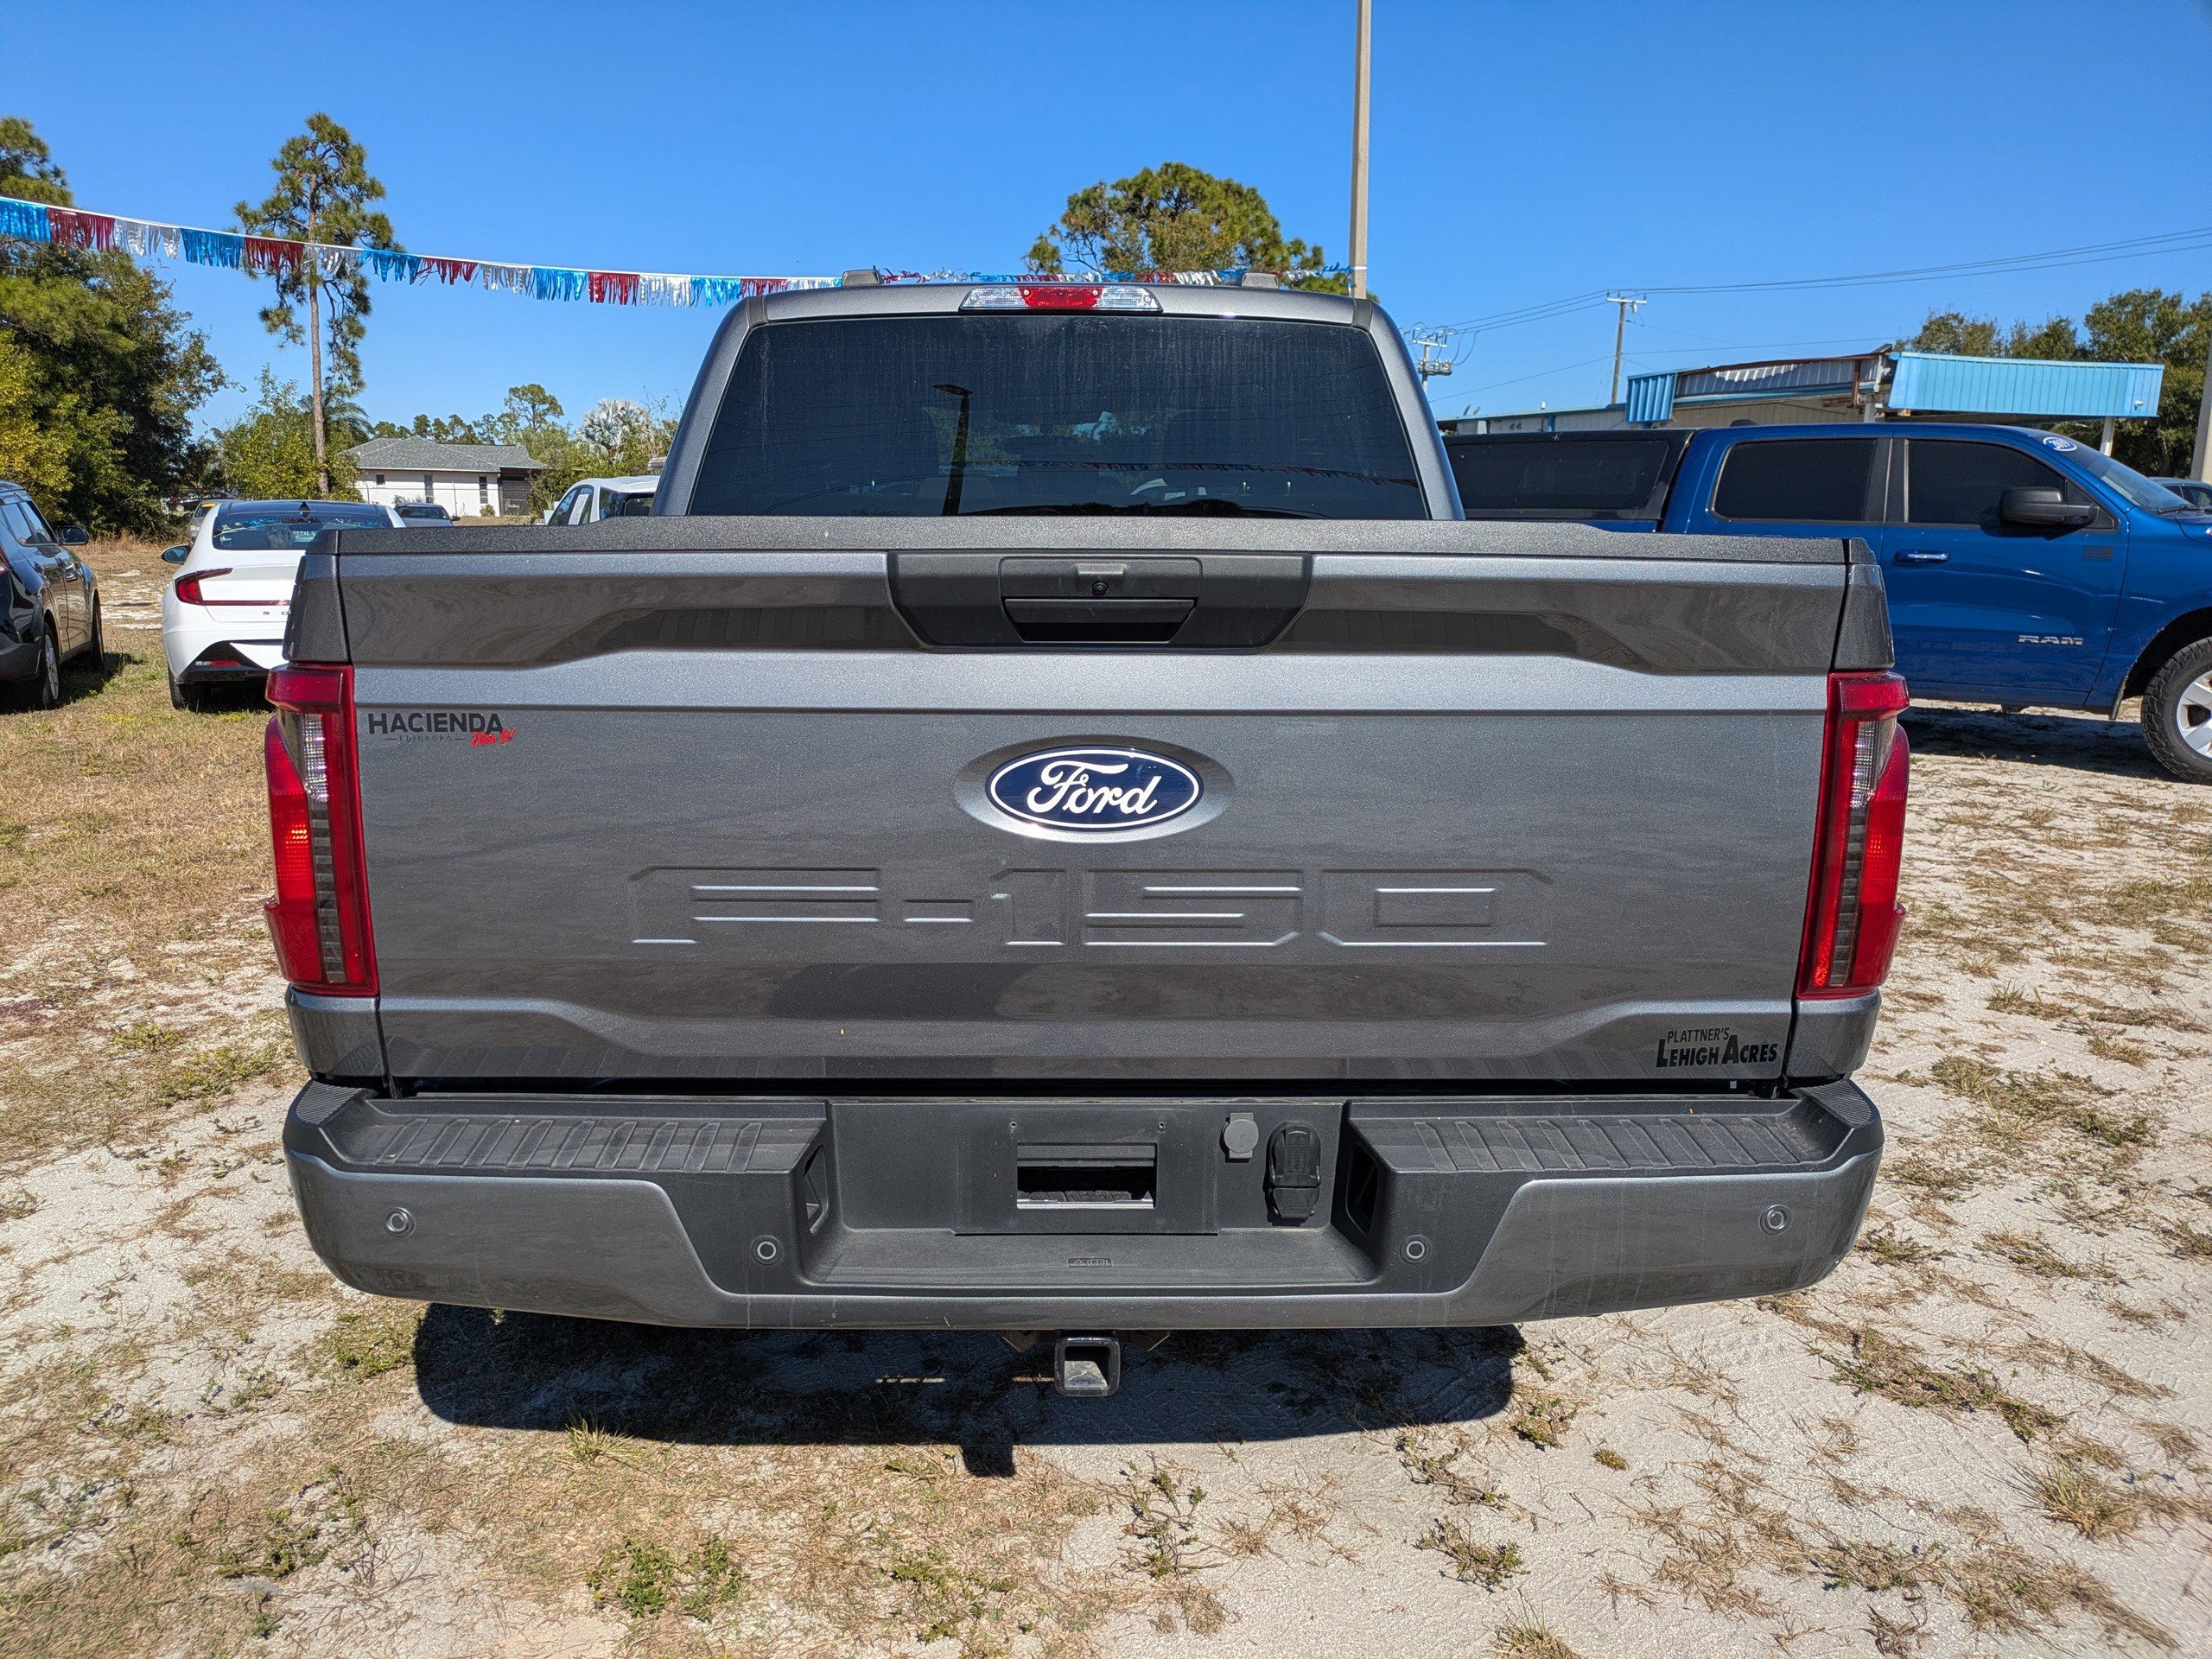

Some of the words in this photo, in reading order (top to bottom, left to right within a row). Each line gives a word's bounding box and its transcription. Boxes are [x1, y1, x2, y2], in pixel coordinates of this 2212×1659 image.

[2018, 634, 2083, 645] RAM
[367, 712, 504, 734] HACIENDA
[1027, 760, 1162, 815] Ford
[628, 866, 1555, 947] F-150
[1667, 1027, 1730, 1044] PLATTNER'S
[1656, 1039, 1719, 1068] LEHIGH
[1721, 1034, 1778, 1064] ACRES
